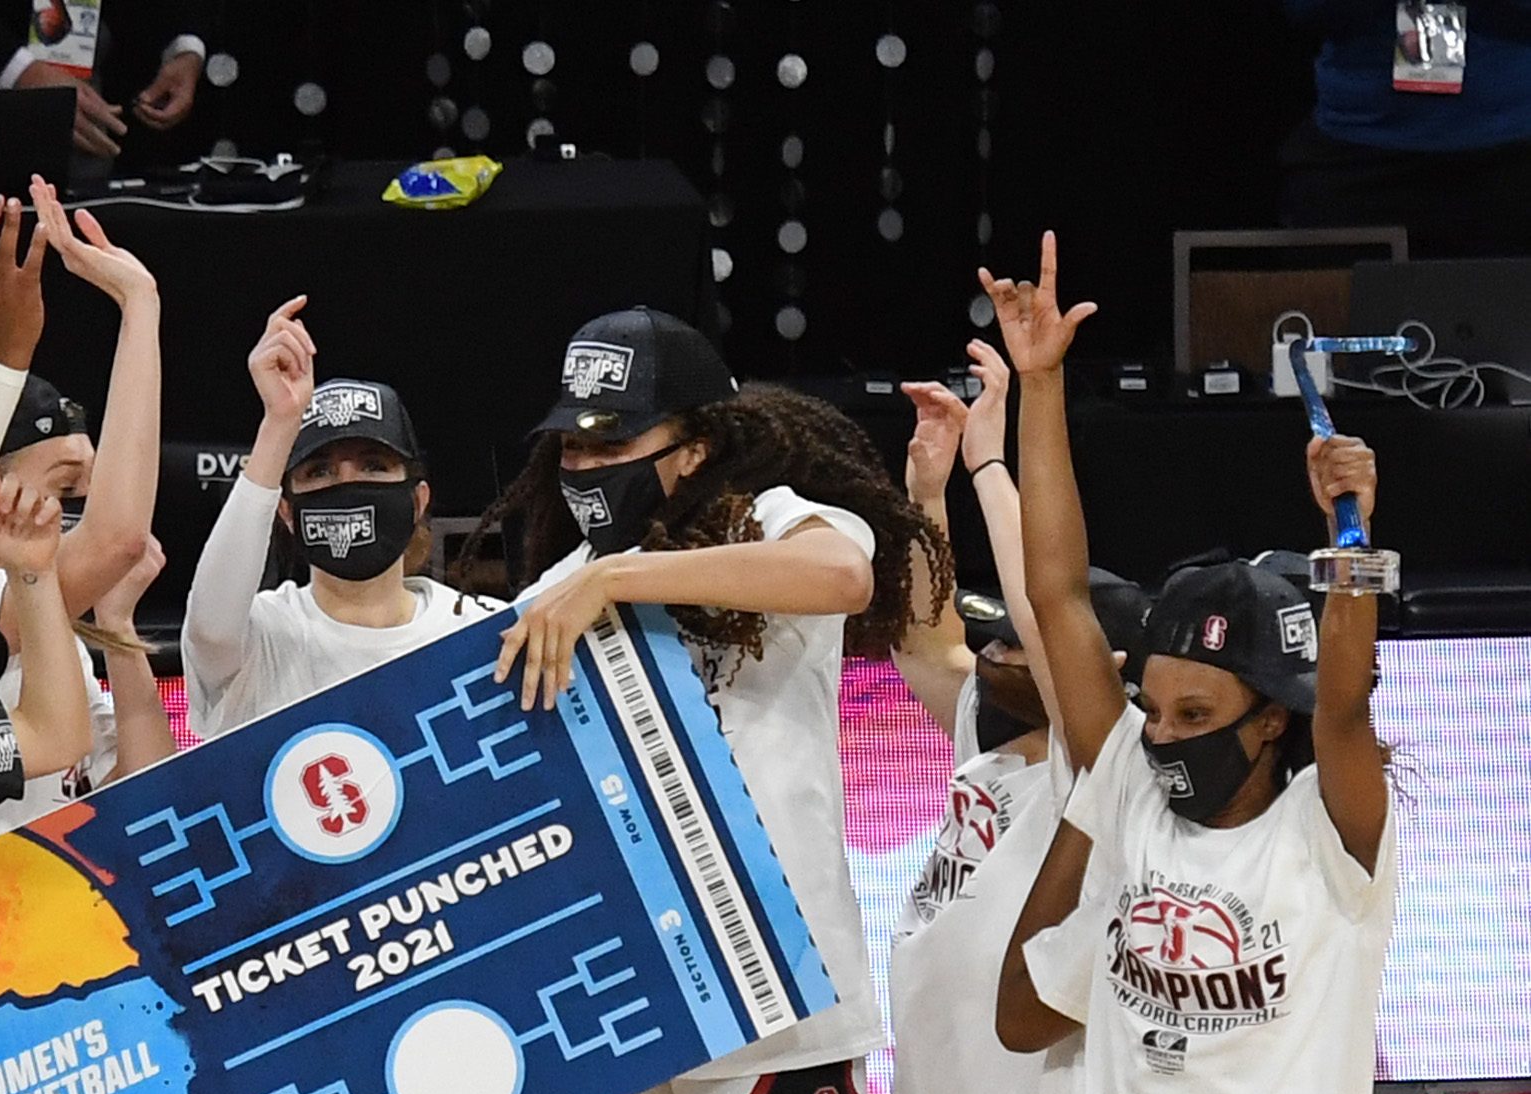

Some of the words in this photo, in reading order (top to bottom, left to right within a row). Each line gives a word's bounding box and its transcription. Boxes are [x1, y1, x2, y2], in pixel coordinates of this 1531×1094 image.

[306, 520, 372, 540] CHMPS
[618, 808, 643, 845] ROW
[193, 918, 352, 1013] TICKET
[361, 824, 573, 938] PUNCHED
[1260, 919, 1283, 950] 21
[353, 919, 458, 993] 2021
[673, 933, 712, 1004] SECTION
